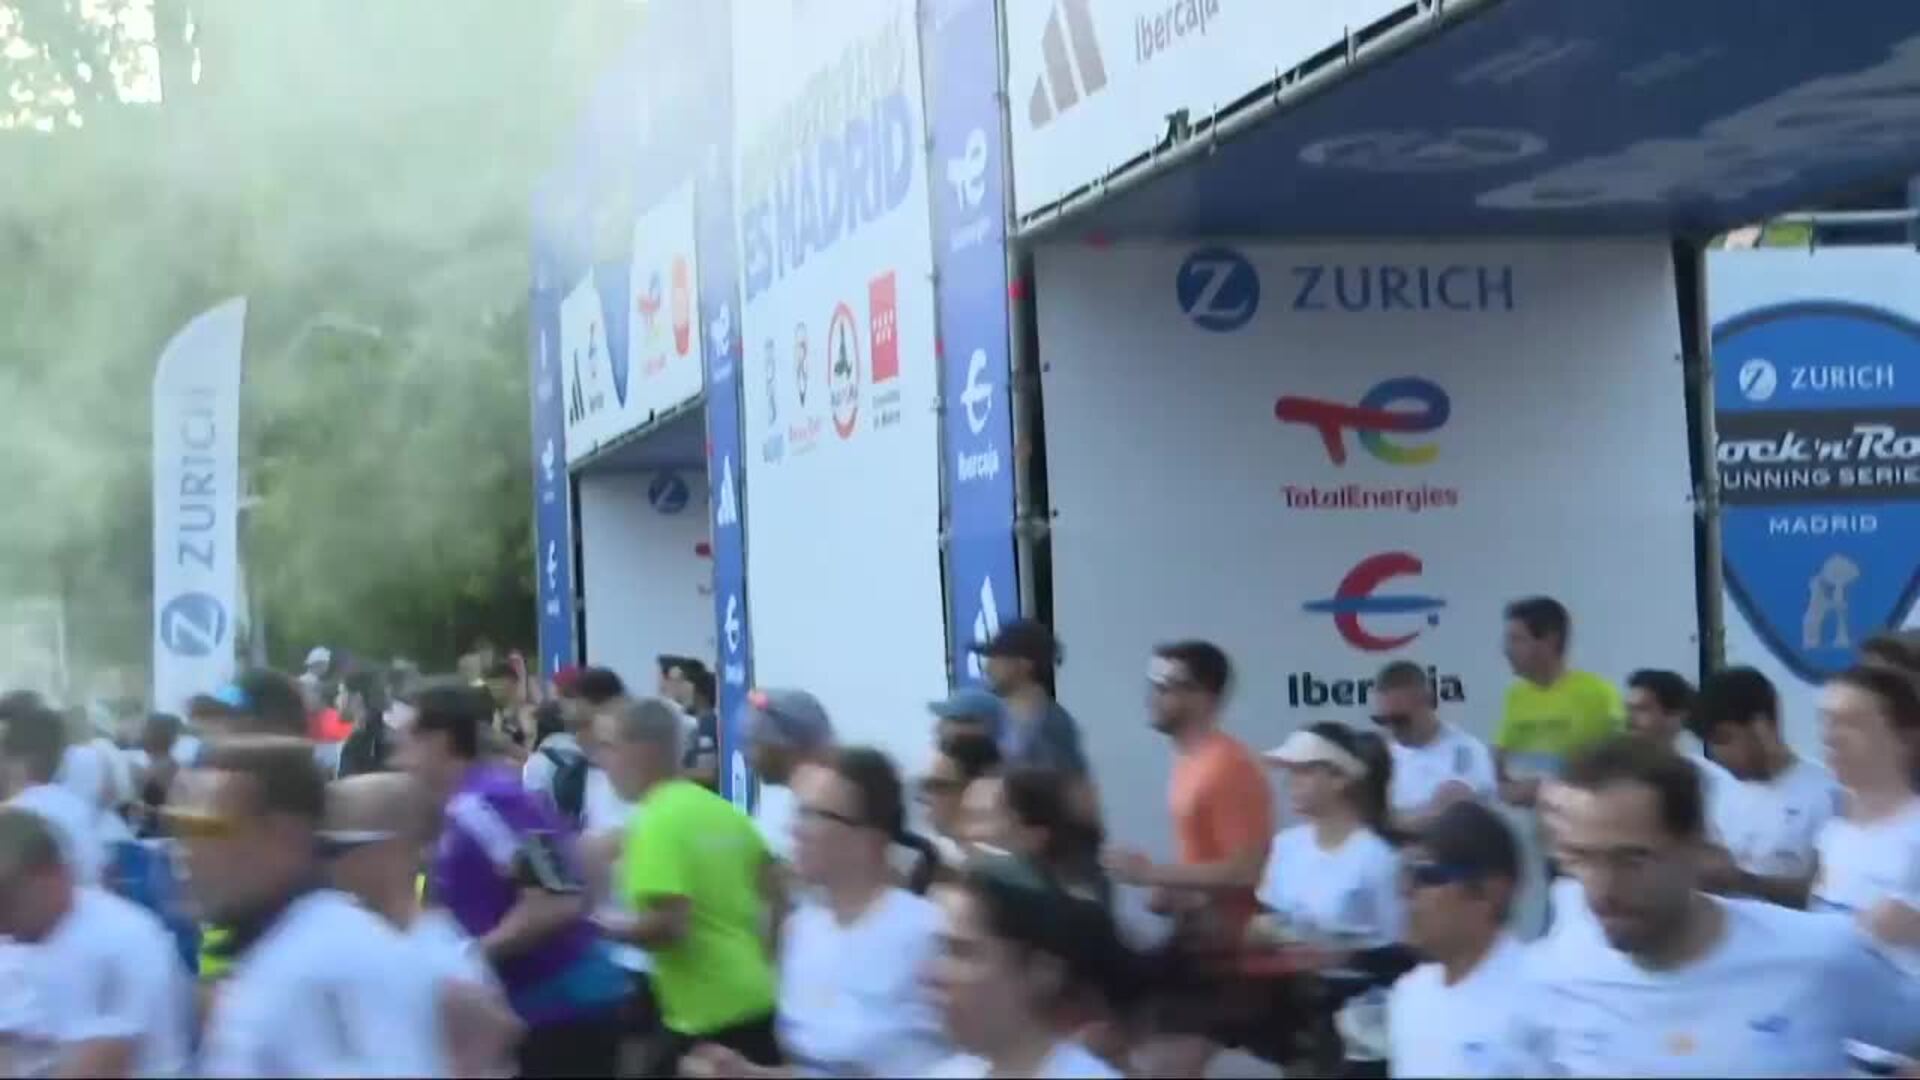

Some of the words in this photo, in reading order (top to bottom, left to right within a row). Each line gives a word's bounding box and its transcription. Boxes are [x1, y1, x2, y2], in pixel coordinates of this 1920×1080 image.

[775, 89, 913, 279] MADRID
[1291, 264, 1516, 312] ZURICH
[1790, 364, 1895, 392] ZURICH
[1716, 429, 1811, 463] ock
[1853, 422, 1920, 463] Ro
[178, 385, 217, 571] ZURICH
[1280, 484, 1459, 512] TotalEnergies
[1722, 466, 1832, 491] UNNING
[1838, 464, 1920, 488] SERIE
[1769, 514, 1878, 536] MADRID
[1287, 664, 1465, 709] Iberja
